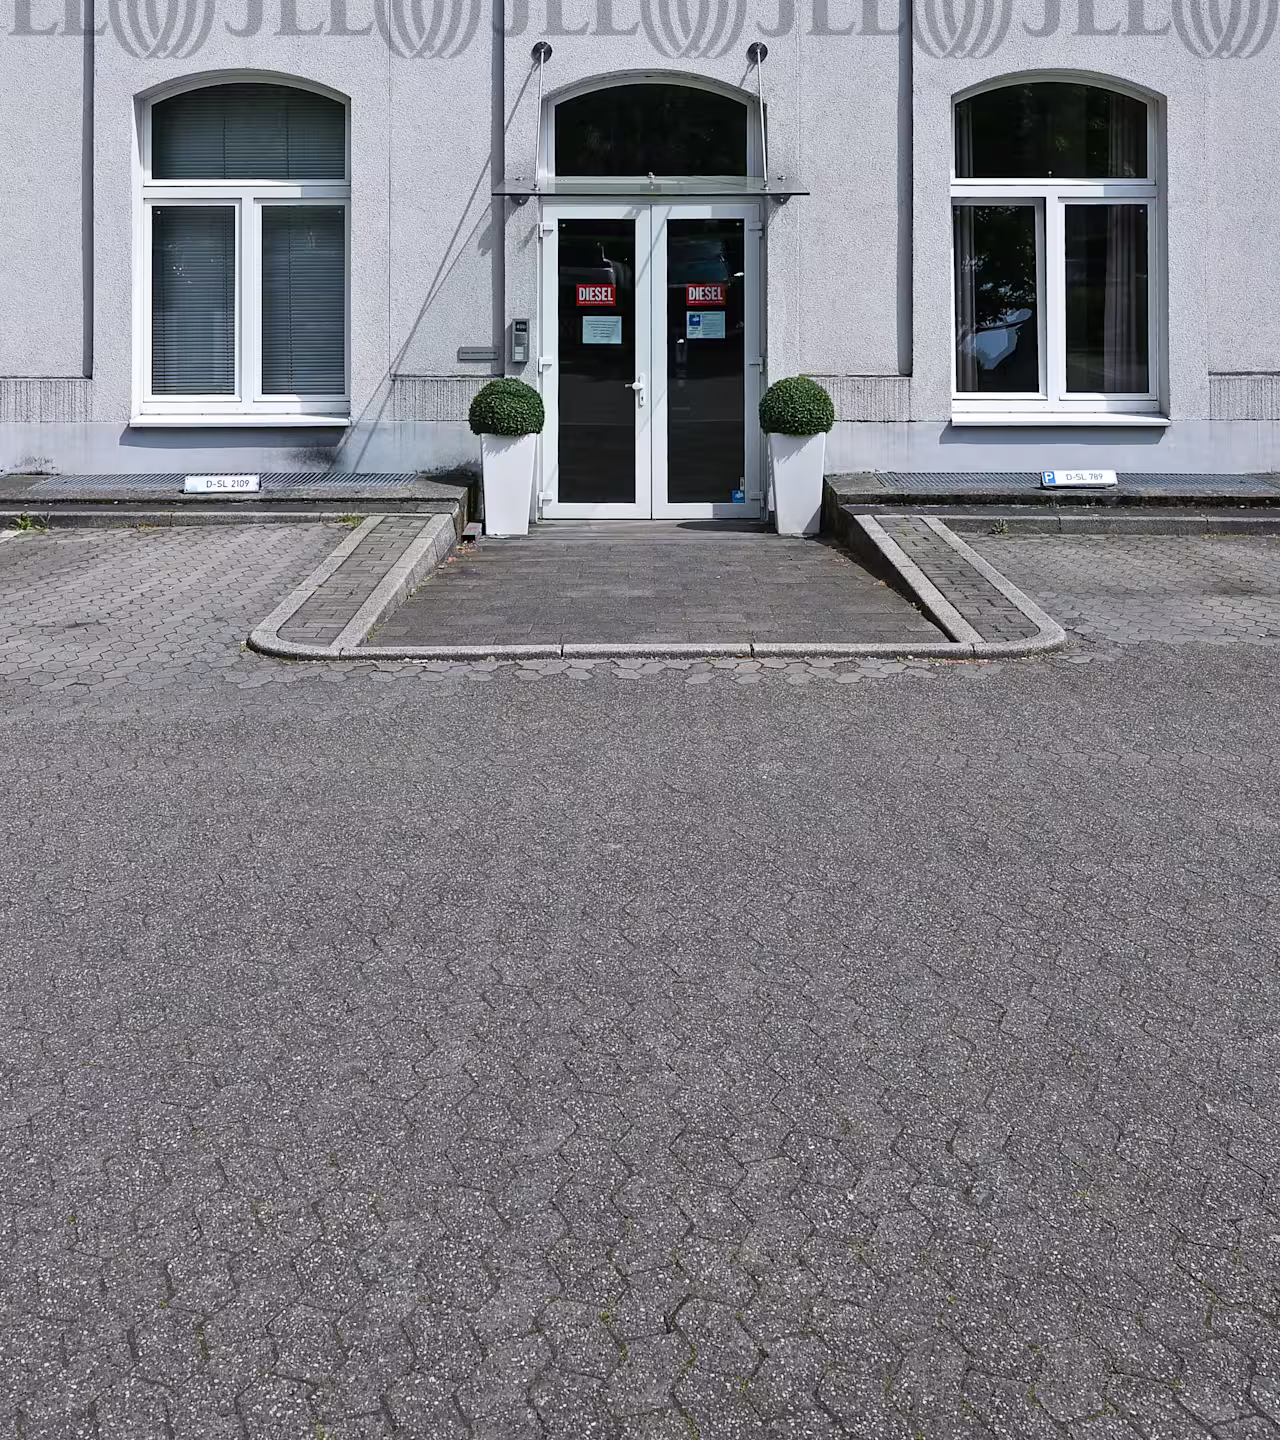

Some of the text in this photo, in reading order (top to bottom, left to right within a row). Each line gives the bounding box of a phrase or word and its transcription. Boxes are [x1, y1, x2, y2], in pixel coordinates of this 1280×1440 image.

[578, 287, 613, 301] DIESEL
[688, 286, 723, 301] DIESEL
[231, 479, 250, 488] 2109
[1044, 472, 1053, 484] P
